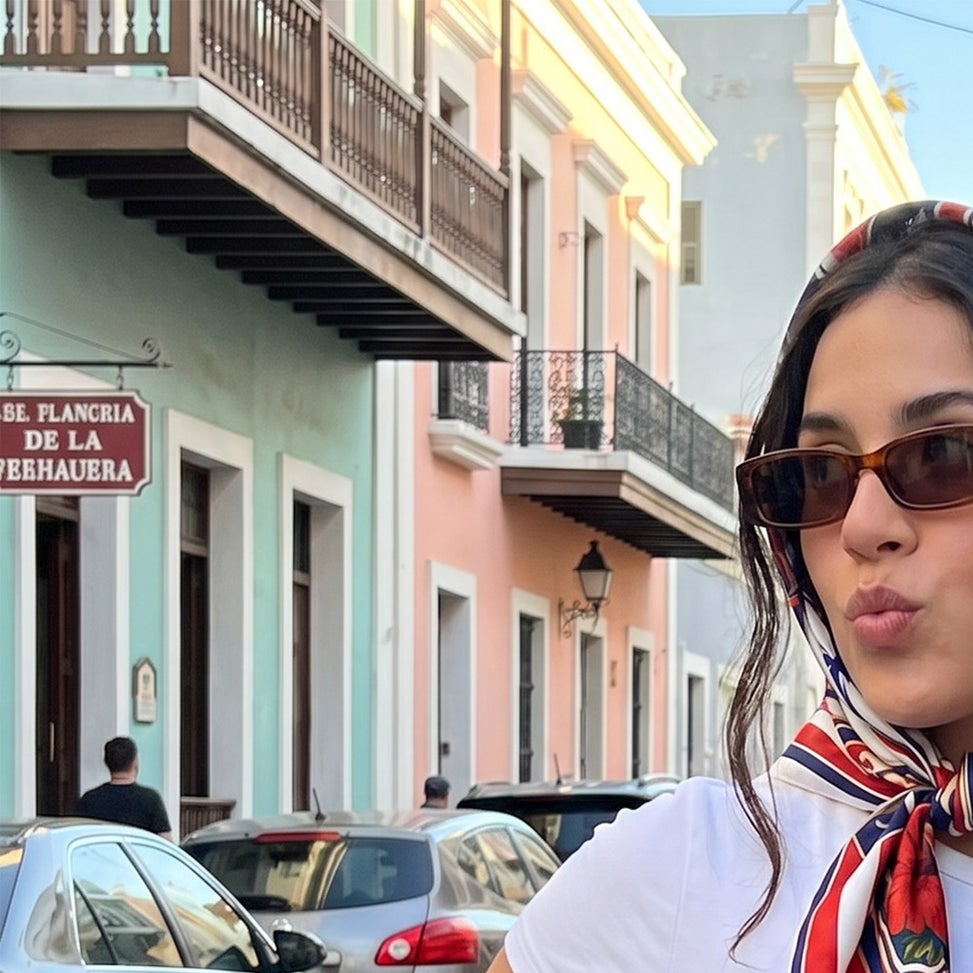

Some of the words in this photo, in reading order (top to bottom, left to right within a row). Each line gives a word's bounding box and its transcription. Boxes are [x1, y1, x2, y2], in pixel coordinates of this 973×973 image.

[0, 403, 30, 423] BE.
[23, 430, 60, 451] DE
[67, 430, 103, 451] LA
